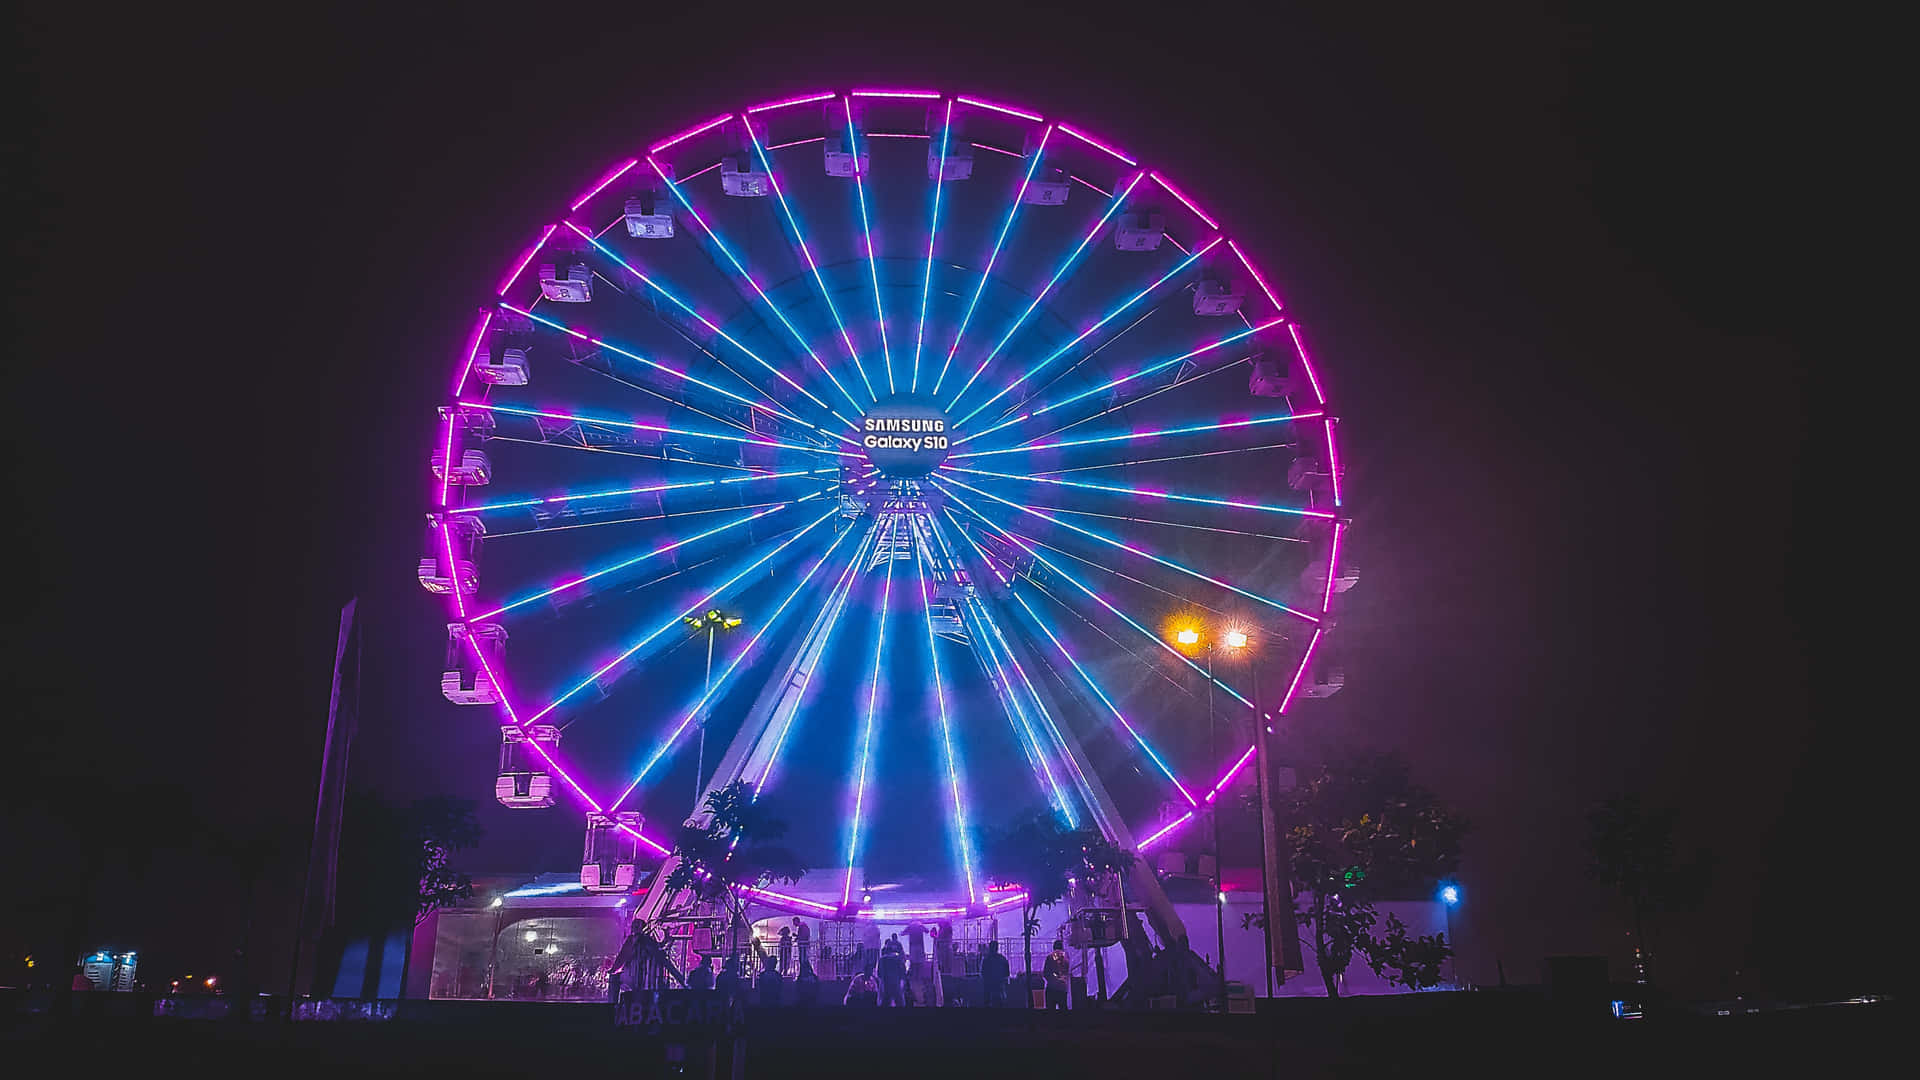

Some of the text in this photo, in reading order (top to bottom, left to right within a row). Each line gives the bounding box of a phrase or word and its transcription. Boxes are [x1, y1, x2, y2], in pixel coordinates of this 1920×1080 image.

[864, 418, 944, 433] SAMSUNG
[864, 435, 948, 452] Galaxy S10
